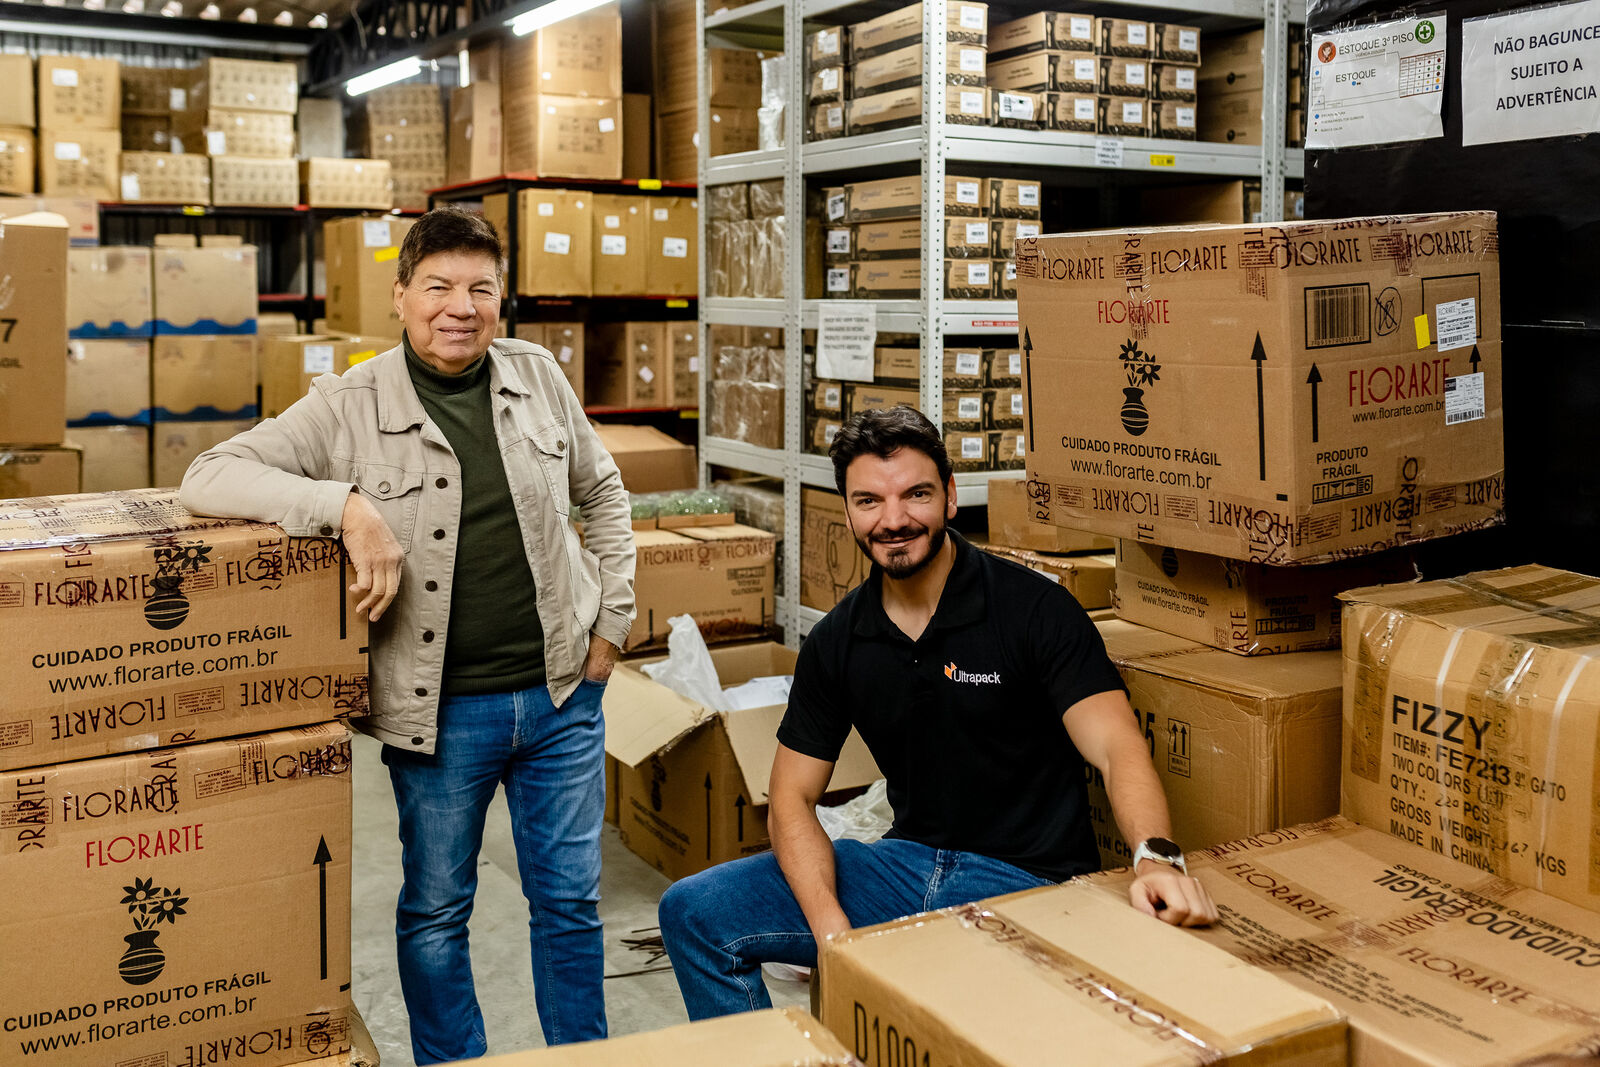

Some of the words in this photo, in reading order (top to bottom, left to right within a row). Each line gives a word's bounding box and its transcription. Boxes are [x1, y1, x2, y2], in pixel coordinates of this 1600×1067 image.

[1338, 38, 1380, 56] ESTOQUE
[1392, 32, 1415, 45] PISO
[1493, 36, 1525, 55] NÃO
[1529, 25, 1600, 50] BAGUNCE
[1335, 69, 1377, 83] ESTOQUE
[1511, 60, 1568, 81] SUJEITO
[1572, 58, 1583, 72] A
[1496, 85, 1598, 111] ADVERTÊNCIA
[1042, 257, 1104, 280] FLORARTE
[1151, 245, 1228, 275] FLORARTE
[1098, 300, 1169, 324] FLORARTE
[1350, 359, 1450, 407] FLORARTE
[1352, 401, 1445, 423] www.florarte.com.br
[1061, 436, 1111, 453] CUIDADO
[1113, 442, 1171, 460] PRODUTO
[1175, 448, 1222, 466] FRÁGIL
[1316, 446, 1368, 464] PRODUTO
[1071, 459, 1212, 490] www.florarte.com.br
[1323, 463, 1361, 480] FRÁGIL
[1092, 488, 1159, 516] FLORARTE
[644, 548, 693, 566] FLORARTE
[34, 574, 151, 607] FLORARTE
[1137, 580, 1160, 594] CUIDADO
[1160, 588, 1188, 601] PRODUTO
[1188, 594, 1210, 607] FRÁGIL
[1141, 594, 1206, 618] www.florarte.com.br
[32, 645, 124, 669] CUIDADO
[129, 632, 221, 657] PRODUTO
[227, 624, 292, 645] FRÁGIL
[49, 649, 278, 694] www.florarte.com.br
[953, 669, 1002, 686] Ultrapack
[51, 696, 165, 740] FLORARTE
[1392, 694, 1491, 750] FIZZY
[1393, 732, 1431, 759] ITEM#:
[1392, 753, 1415, 774] TWO
[1417, 762, 1471, 795] COLORS
[64, 782, 180, 822] FLORARTE
[1463, 801, 1490, 825] PCS
[86, 824, 204, 868] FLORARTE
[1391, 797, 1432, 826] GROSS
[1535, 850, 1567, 876] KGS
[1391, 819, 1424, 847] MADE
[1431, 835, 1444, 855] IN
[1227, 862, 1340, 921] FLORARTE
[1398, 946, 1535, 1004] FLORARTE
[4, 1003, 97, 1032] CUIDADO
[103, 984, 198, 1014] PRODUTO
[204, 971, 272, 996] FRÁGIL
[20, 996, 257, 1056] www.florarte.com.br
